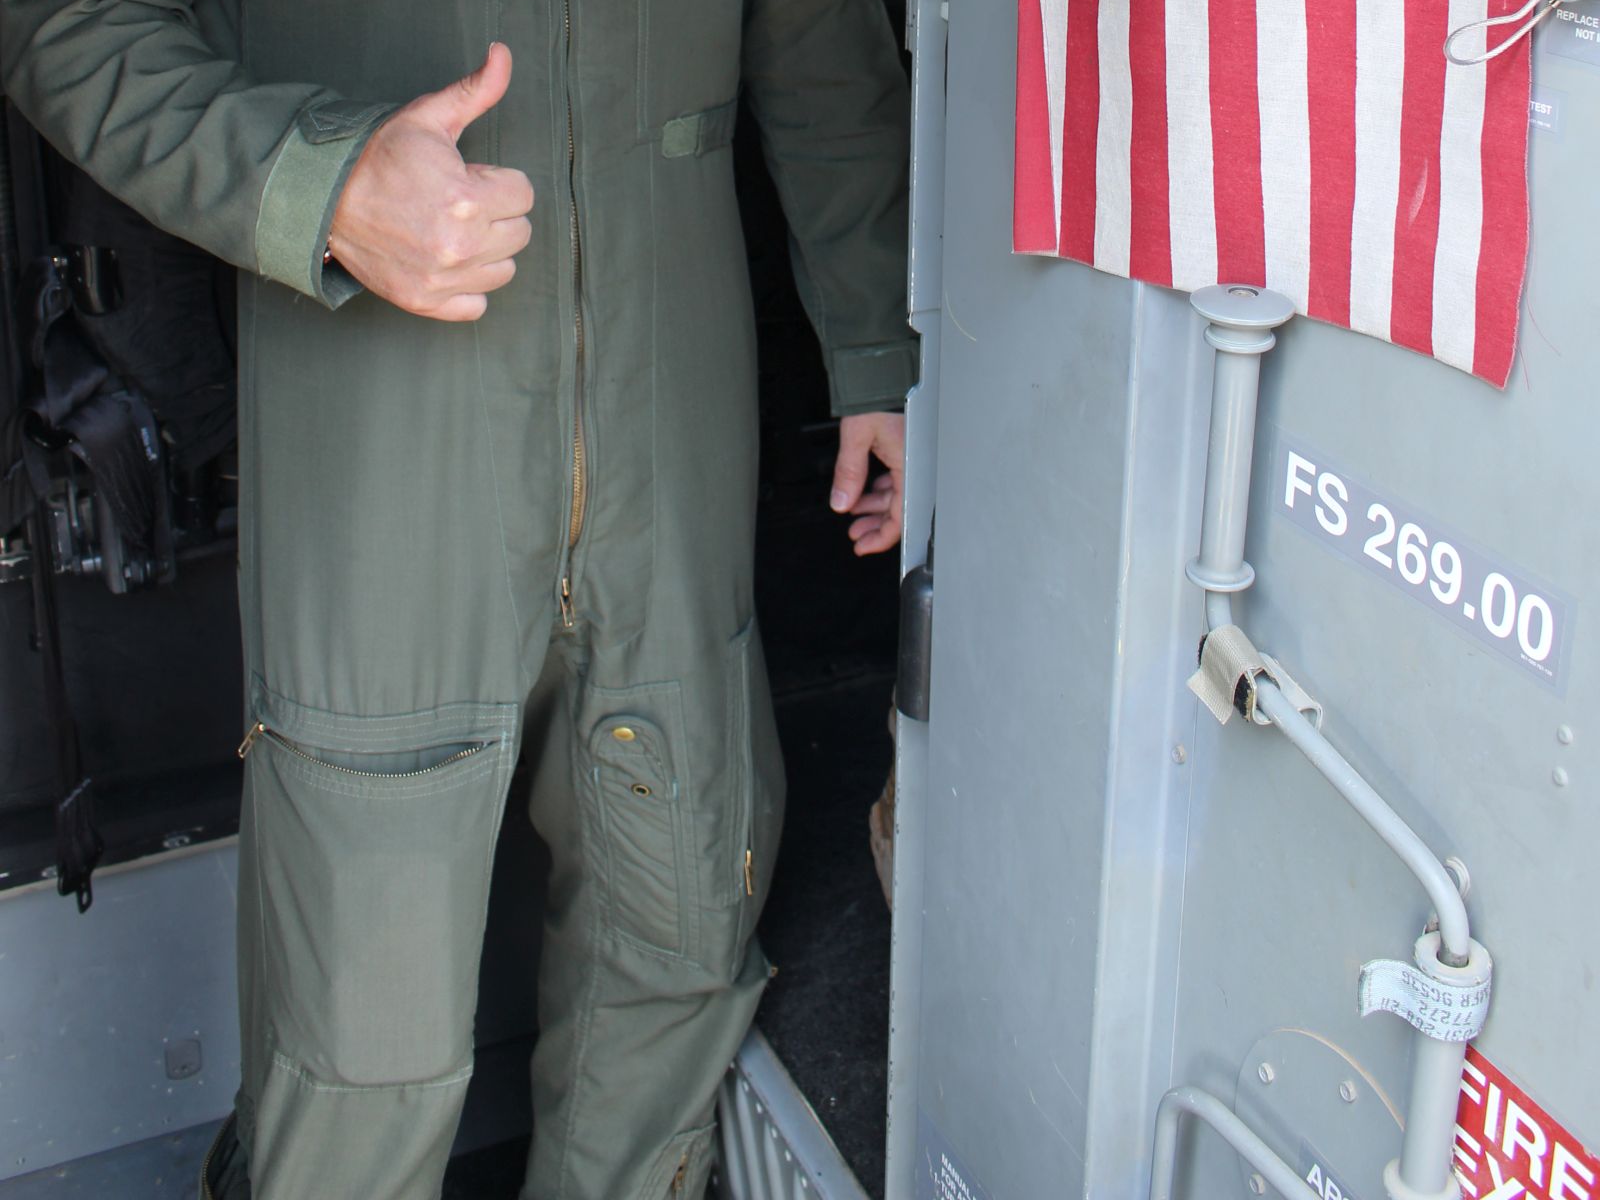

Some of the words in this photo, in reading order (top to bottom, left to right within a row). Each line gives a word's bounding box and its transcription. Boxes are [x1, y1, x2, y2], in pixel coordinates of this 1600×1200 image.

[1556, 9, 1599, 28] REPLACE
[1575, 27, 1595, 40] NOT
[1284, 450, 1349, 537] FS
[1363, 502, 1554, 663] 269.00
[1459, 1059, 1595, 1200] FIRE
[941, 1153, 971, 1200] MANUAL
[941, 1167, 956, 1194] FOR
